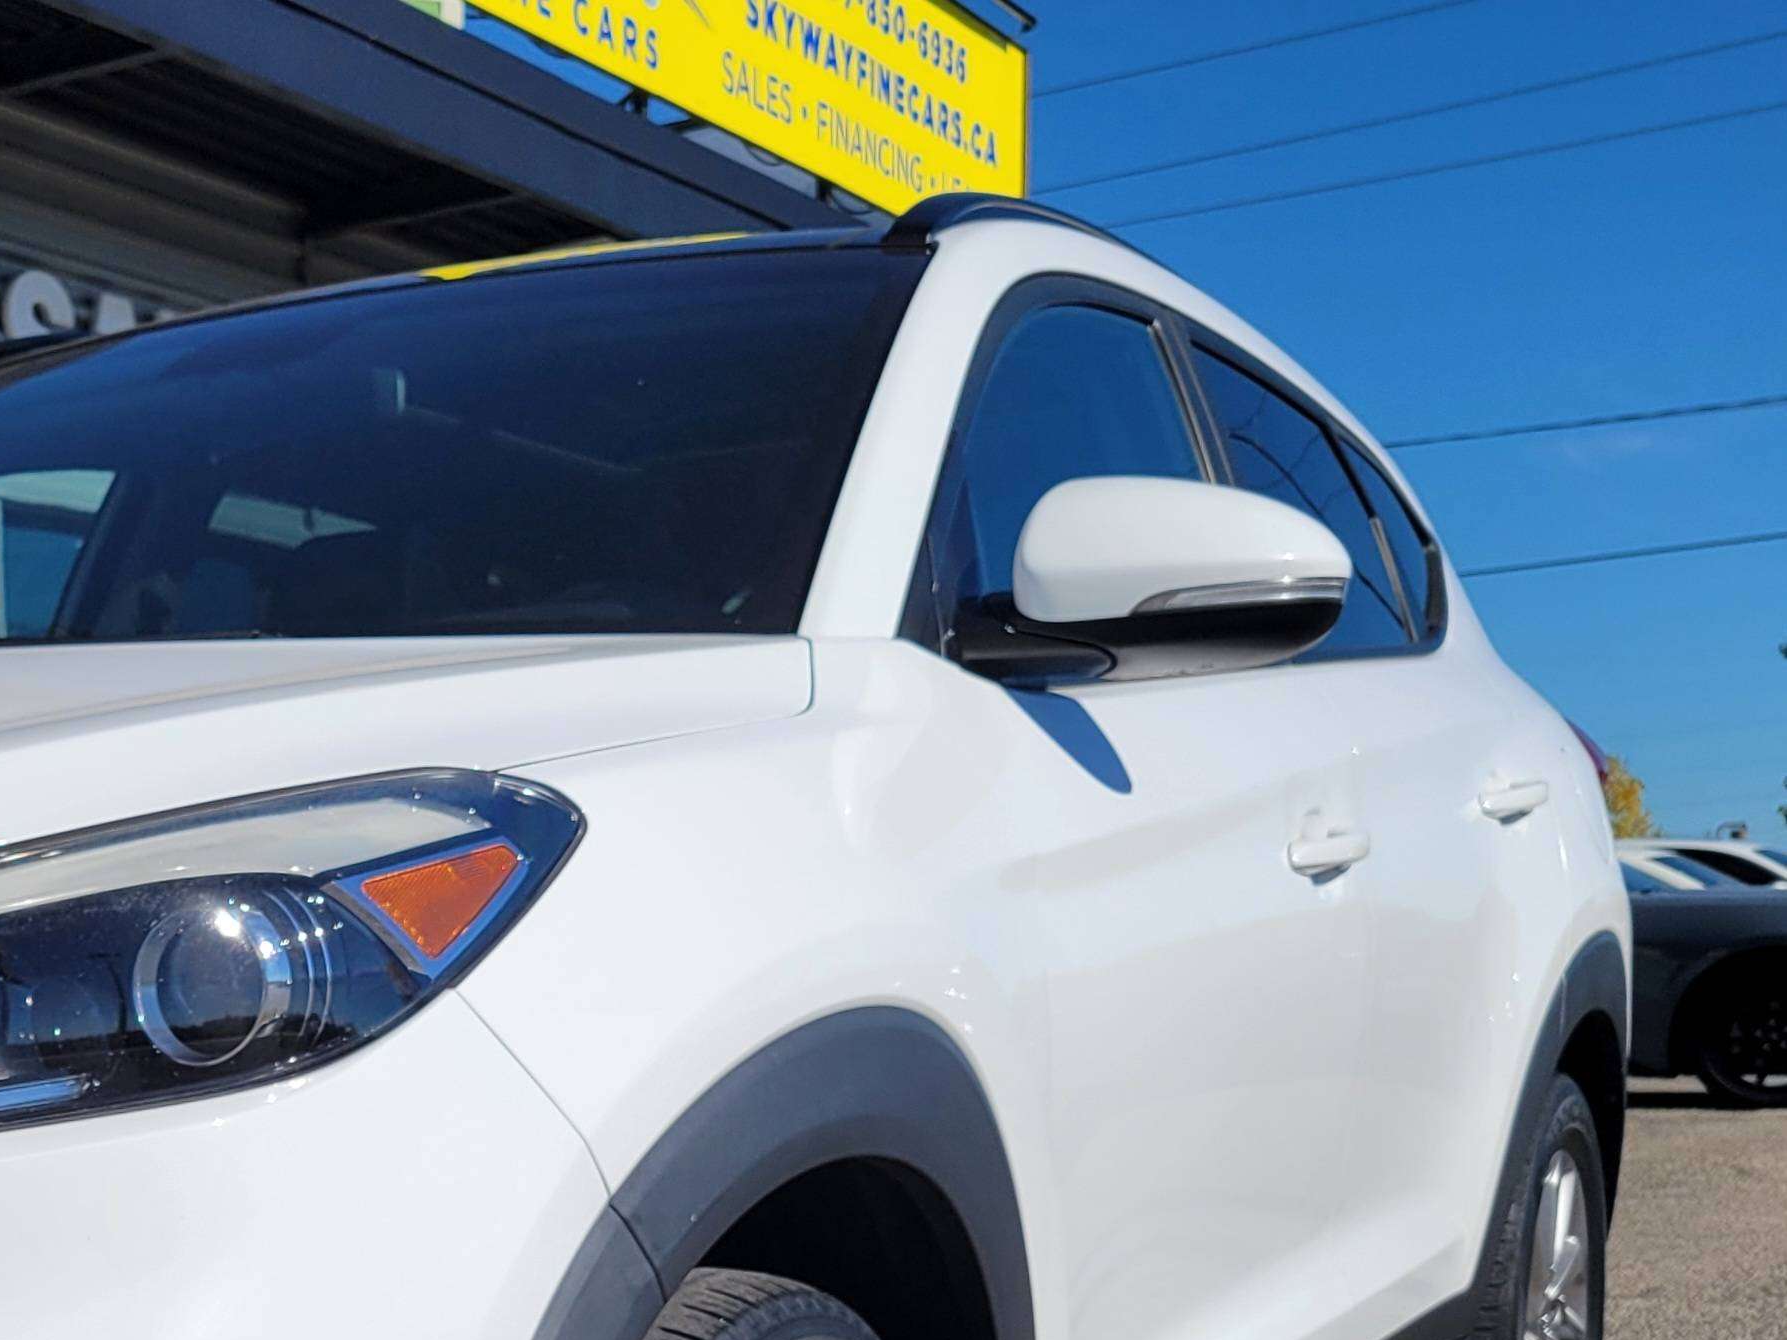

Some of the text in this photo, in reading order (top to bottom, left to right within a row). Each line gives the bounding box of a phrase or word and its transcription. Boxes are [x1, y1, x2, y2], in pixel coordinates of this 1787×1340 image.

[573, 0, 659, 69] CARS
[745, 0, 997, 168] SKYWAYFINECARS.CA
[721, 50, 923, 193] SALES FINANCING
